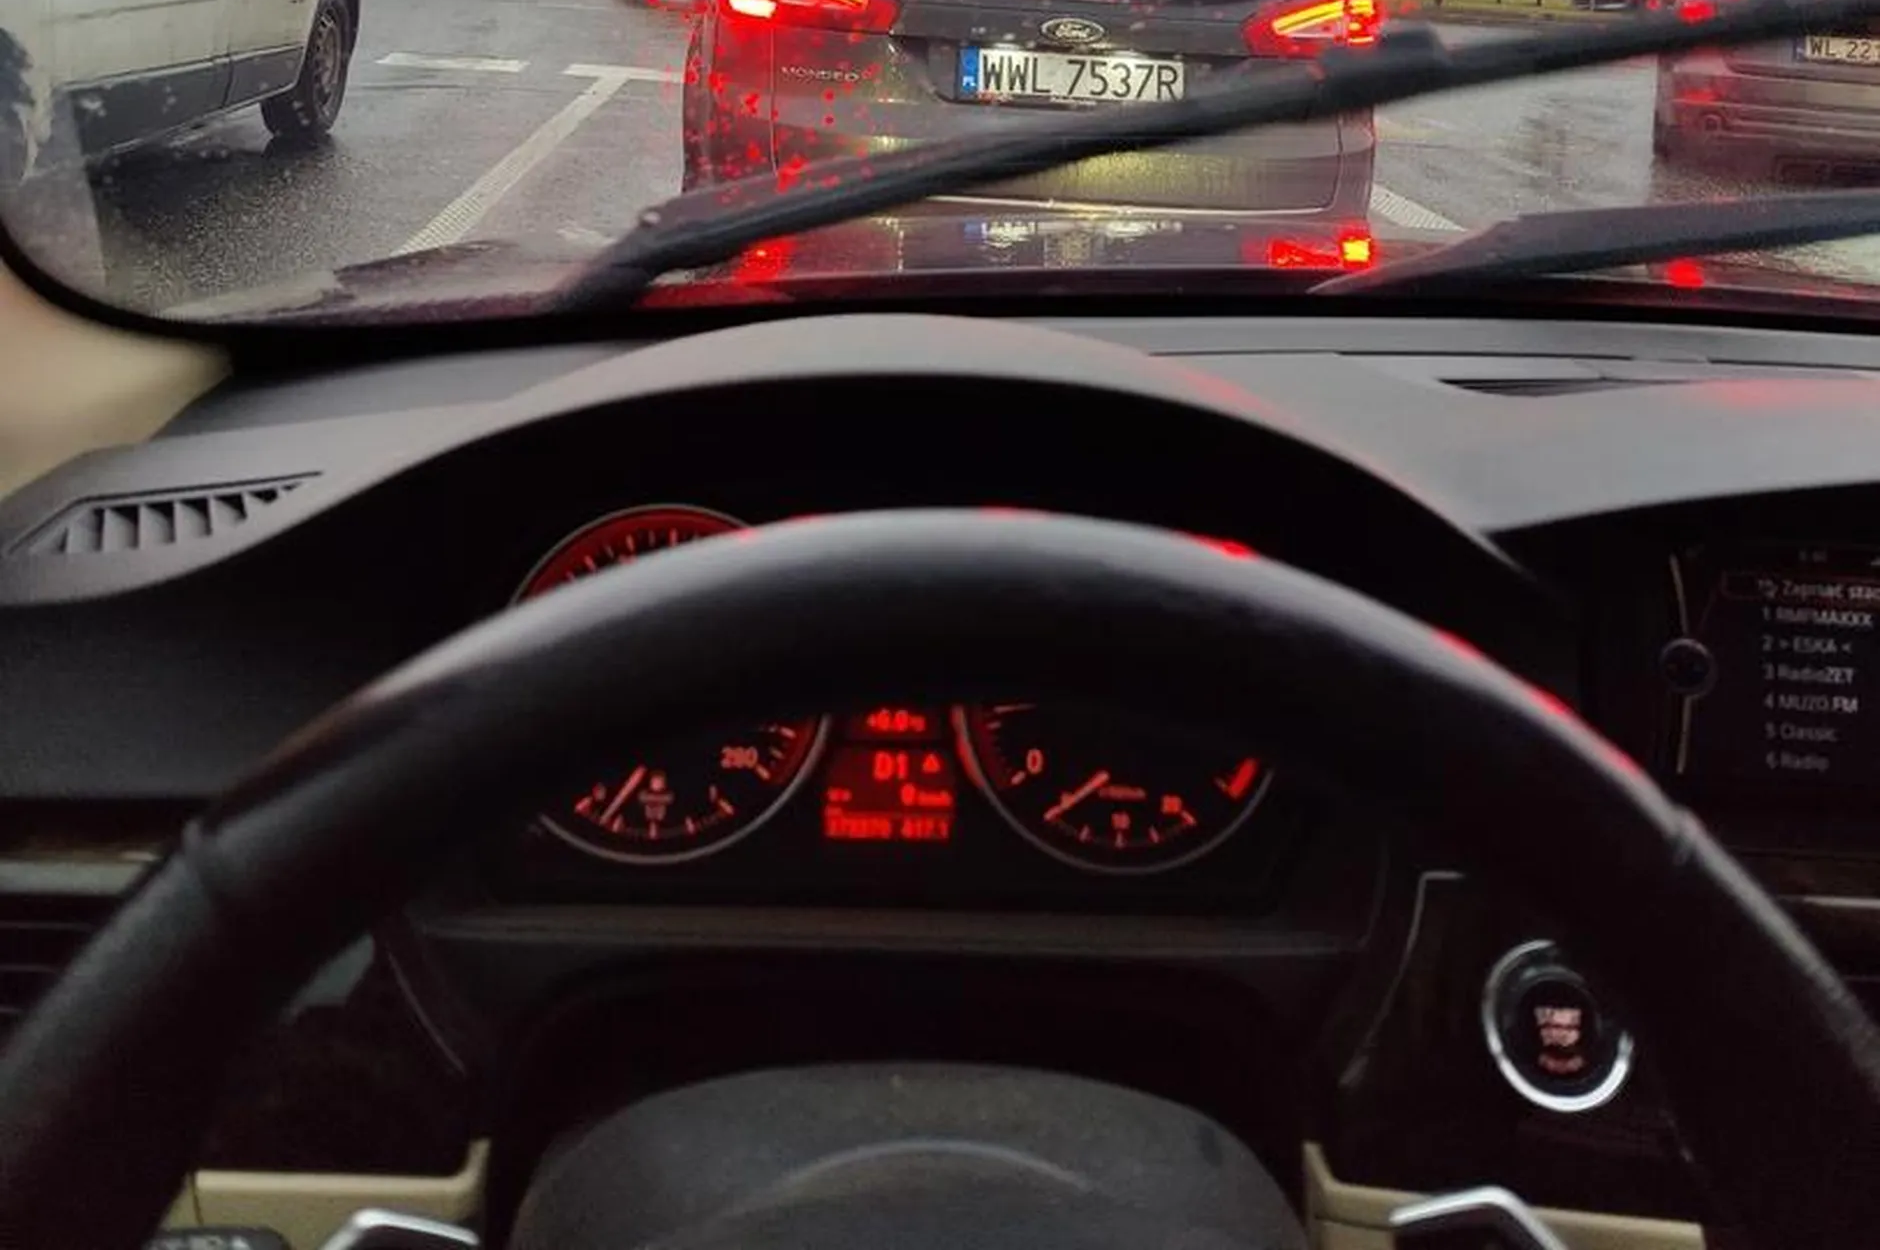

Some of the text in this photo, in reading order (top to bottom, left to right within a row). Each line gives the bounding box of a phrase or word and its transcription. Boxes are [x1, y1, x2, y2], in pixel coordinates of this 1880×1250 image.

[1809, 38, 1880, 61] WL 22
[982, 53, 1177, 100] WWL 7537R
[1026, 748, 1043, 774] 0
